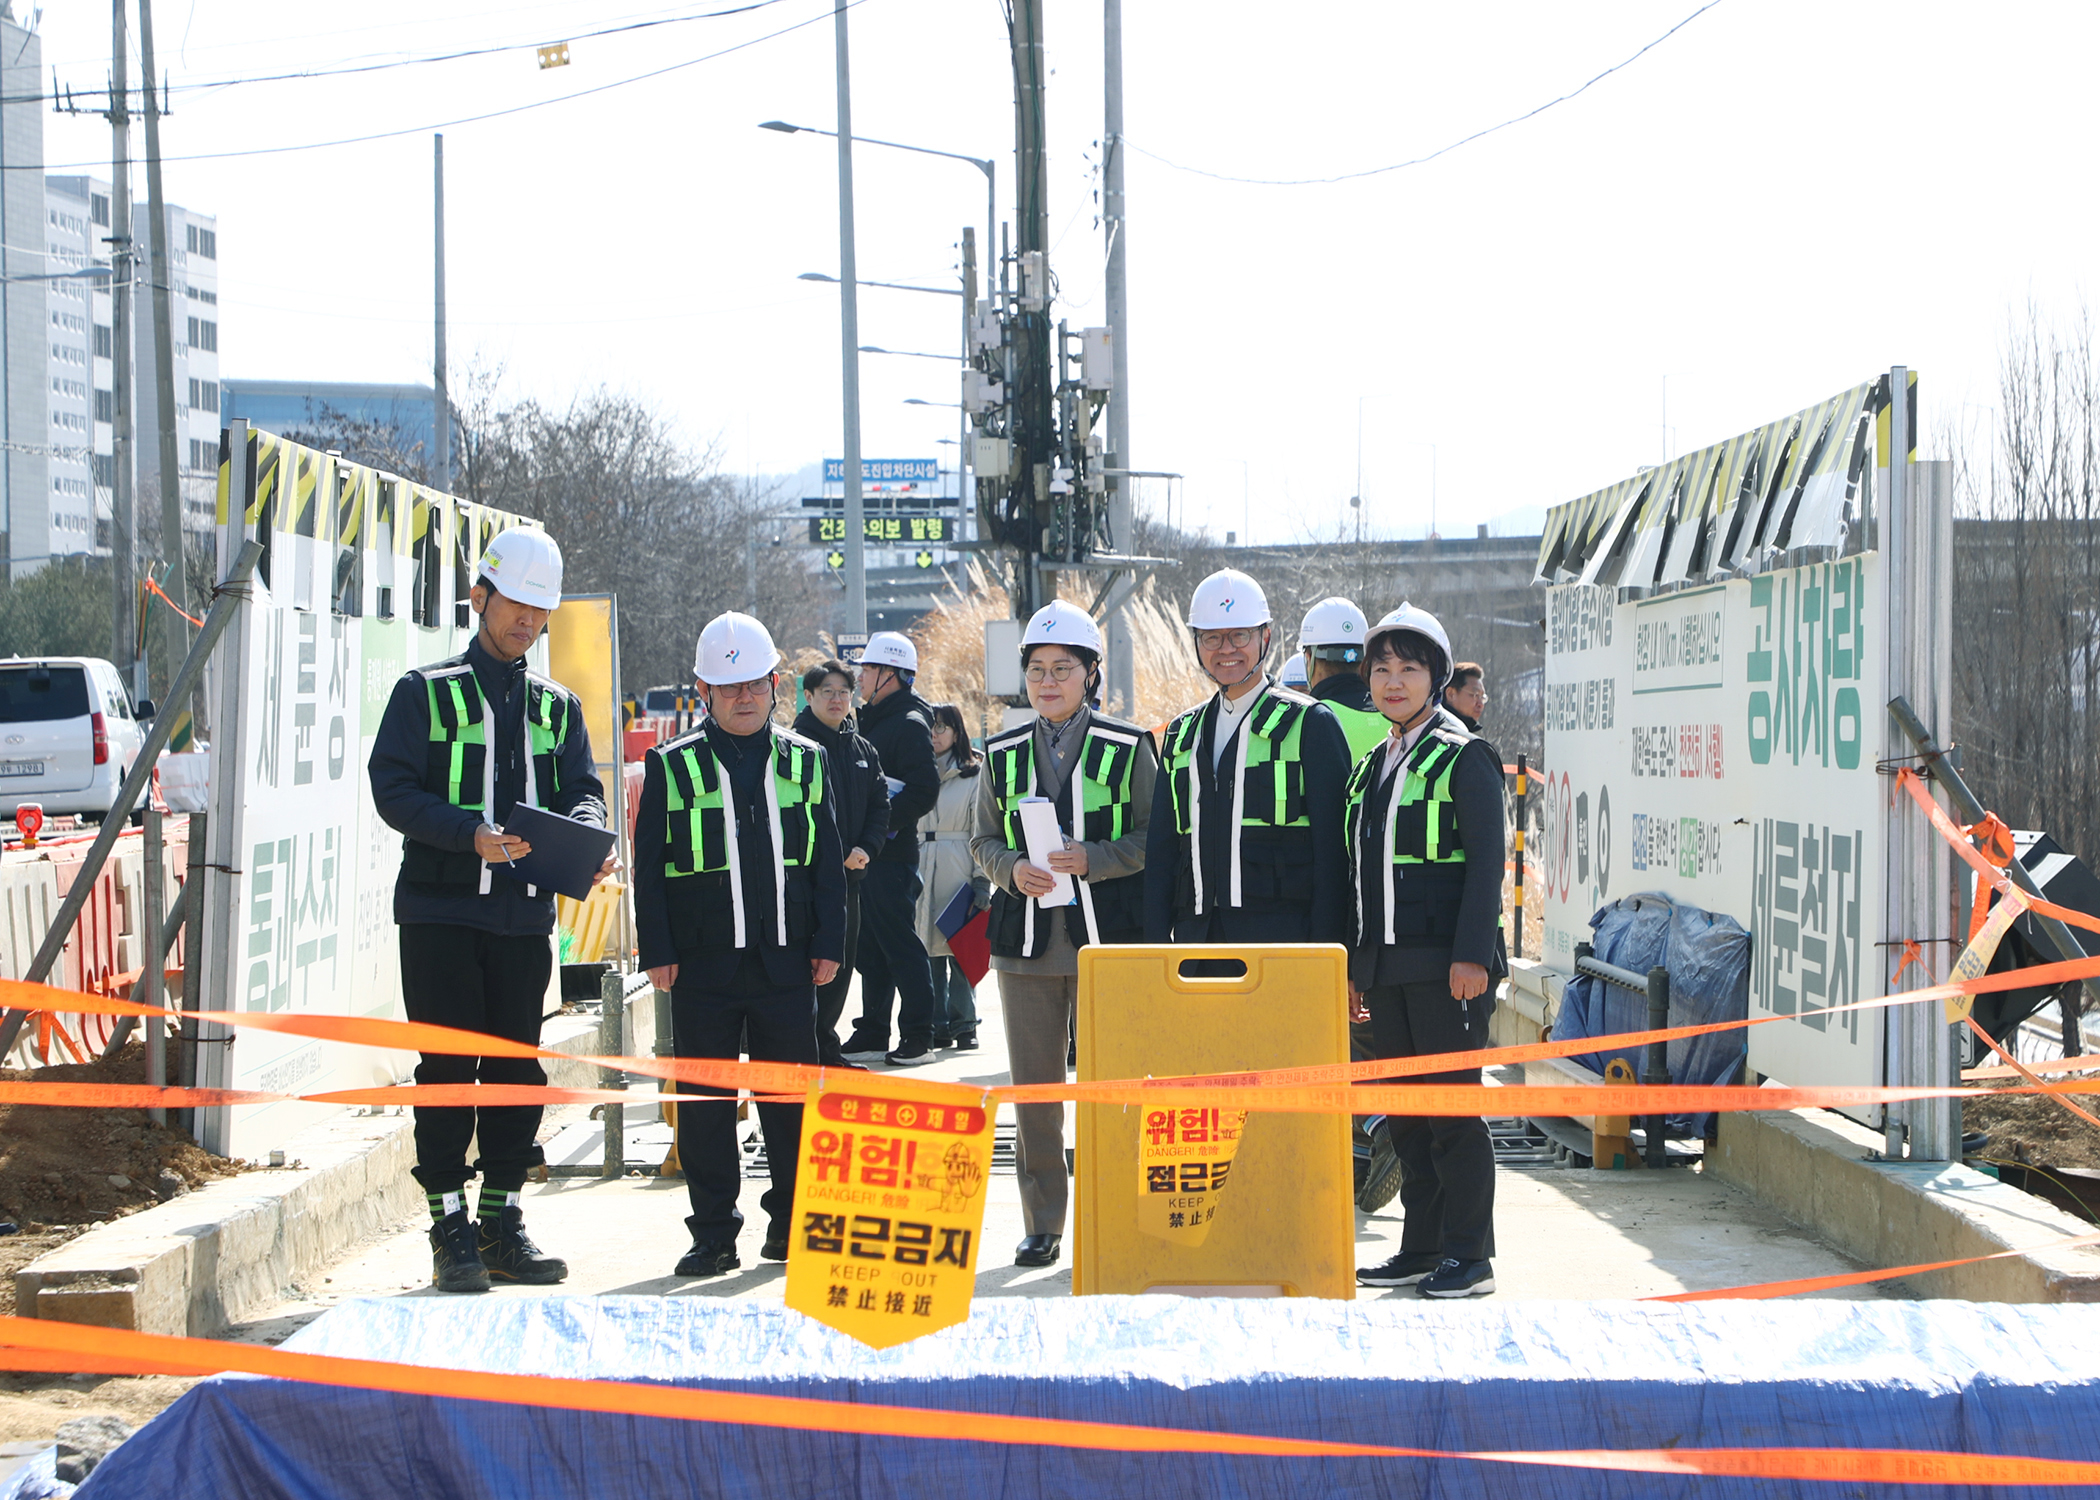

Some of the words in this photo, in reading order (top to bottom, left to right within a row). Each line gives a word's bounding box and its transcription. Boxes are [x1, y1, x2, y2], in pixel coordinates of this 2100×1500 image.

[827, 462, 936, 479] 지도진입차단시설
[910, 518, 943, 541] 발령
[1637, 622, 1650, 672] 현장
[1659, 621, 1677, 669] 10km
[1677, 611, 1721, 667] 서행하십시오
[1747, 557, 1864, 770] 공사차량
[1566, 682, 1582, 731] 반드시
[1583, 679, 1602, 731] 세륜기
[1602, 677, 1616, 730] 통과
[17, 763, 39, 774] 1298
[1631, 726, 1658, 777] 제한속도
[1659, 725, 1677, 779] 준수!
[1679, 724, 1703, 779] 천천히
[1705, 723, 1725, 780] 서행!
[1633, 814, 1654, 870] 안전을
[1655, 817, 1669, 867] 한번
[1670, 818, 1678, 869] 더
[1679, 818, 1722, 877] 생각합시다.
[246, 825, 342, 1014] 통과수칙
[1750, 818, 1863, 1045] 세륜철저
[1276, 1071, 1310, 1085] 안전제일
[1311, 1068, 1345, 1081] 추락주의
[1389, 1060, 1417, 1074] SAFETY
[1417, 1059, 1433, 1071] LINE
[841, 1099, 888, 1123] 안전
[925, 1108, 971, 1132] 제일
[1369, 1093, 1411, 1109] SAFETY
[1413, 1093, 1438, 1109] LINE
[1562, 1095, 1584, 1106] WBK
[1146, 1108, 1219, 1144] 위험!
[809, 1130, 918, 1191] 위험!
[1146, 1147, 1195, 1158] DANGER!
[1147, 1159, 1232, 1193] 접근금
[806, 1185, 878, 1207] DANGER!
[1168, 1197, 1205, 1209] KEEP
[803, 1211, 973, 1270] 접근금지
[829, 1263, 881, 1282] KEEP
[901, 1271, 938, 1288] OUT
